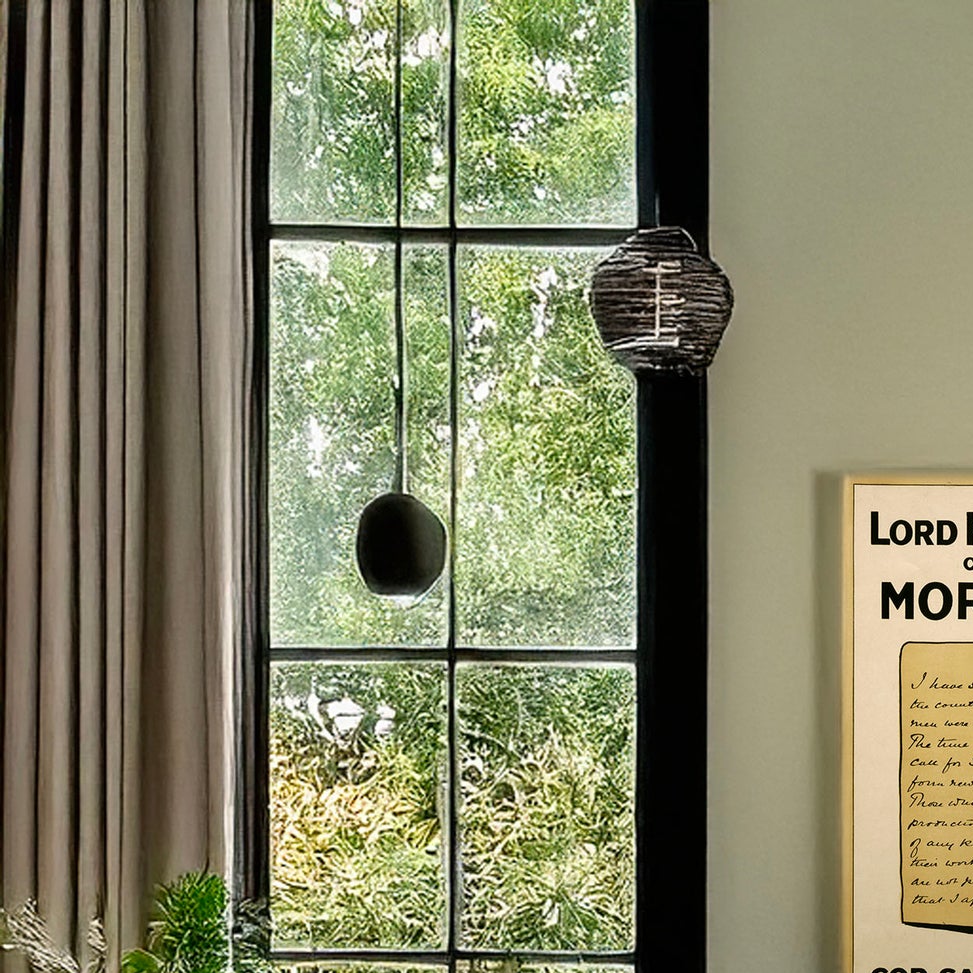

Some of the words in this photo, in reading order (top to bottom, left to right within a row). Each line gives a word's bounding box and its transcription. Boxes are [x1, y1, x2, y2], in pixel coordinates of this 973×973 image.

[870, 511, 958, 546] LORD
[911, 672, 927, 689] I
[929, 677, 963, 689] have
[910, 699, 929, 709] the
[910, 719, 937, 727] men
[908, 733, 931, 750] The
[937, 737, 969, 748] time
[942, 757, 961, 774] for
[907, 775, 945, 793] form
[909, 792, 944, 808] Those
[909, 838, 922, 858] of
[927, 840, 954, 850] any
[910, 856, 938, 868] their
[911, 878, 931, 886] are
[912, 894, 945, 904] that
[949, 893, 960, 903] I
